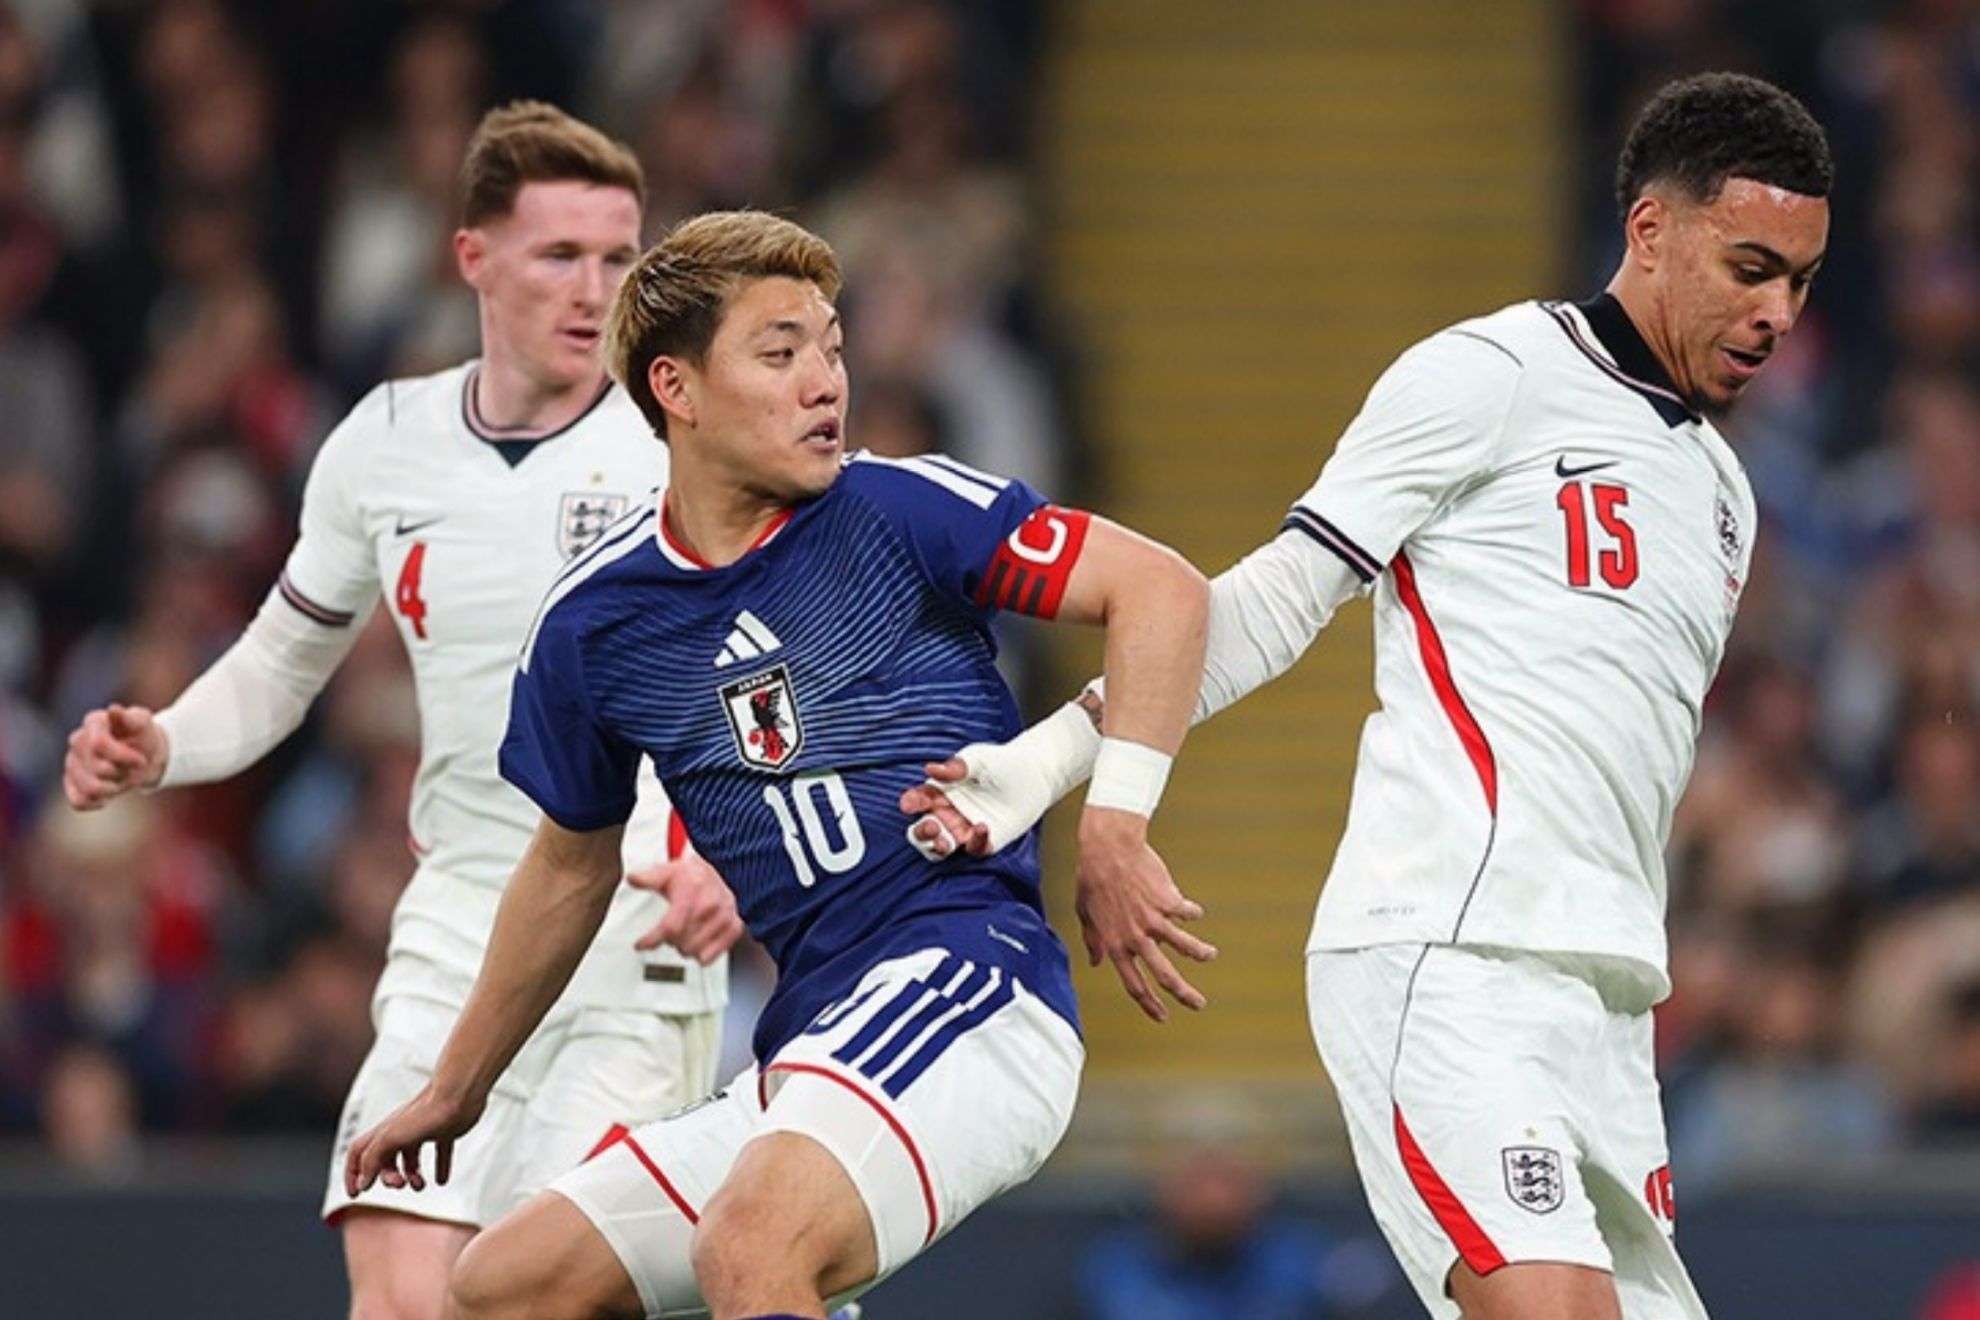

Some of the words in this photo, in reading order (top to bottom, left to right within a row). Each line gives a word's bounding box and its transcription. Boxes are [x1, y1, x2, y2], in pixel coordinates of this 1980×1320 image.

[1008, 517, 1067, 565] C
[1556, 480, 1639, 590] 15
[396, 542, 426, 638] 4
[763, 769, 866, 888] 10
